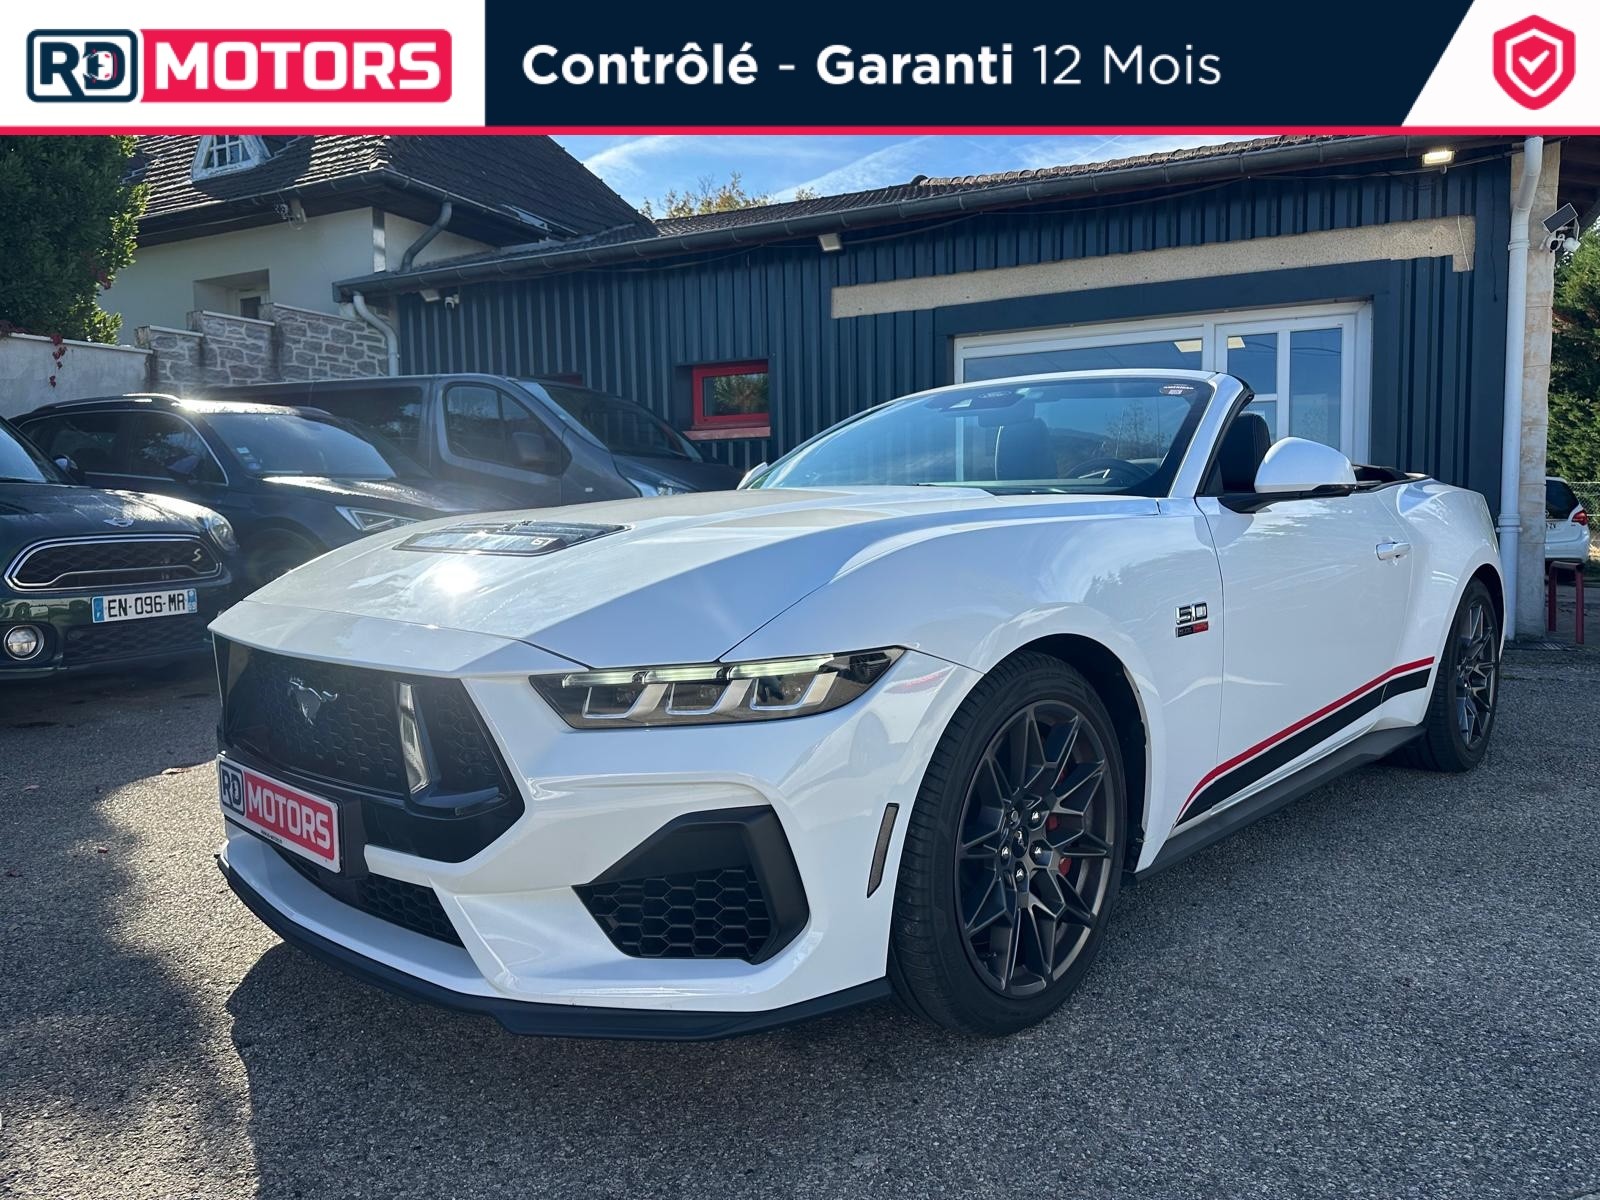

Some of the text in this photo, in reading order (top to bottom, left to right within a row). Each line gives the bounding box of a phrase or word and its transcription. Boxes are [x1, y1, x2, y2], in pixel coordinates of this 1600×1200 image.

[192, 548, 202, 562] S
[221, 768, 331, 850] RD MOTORS
